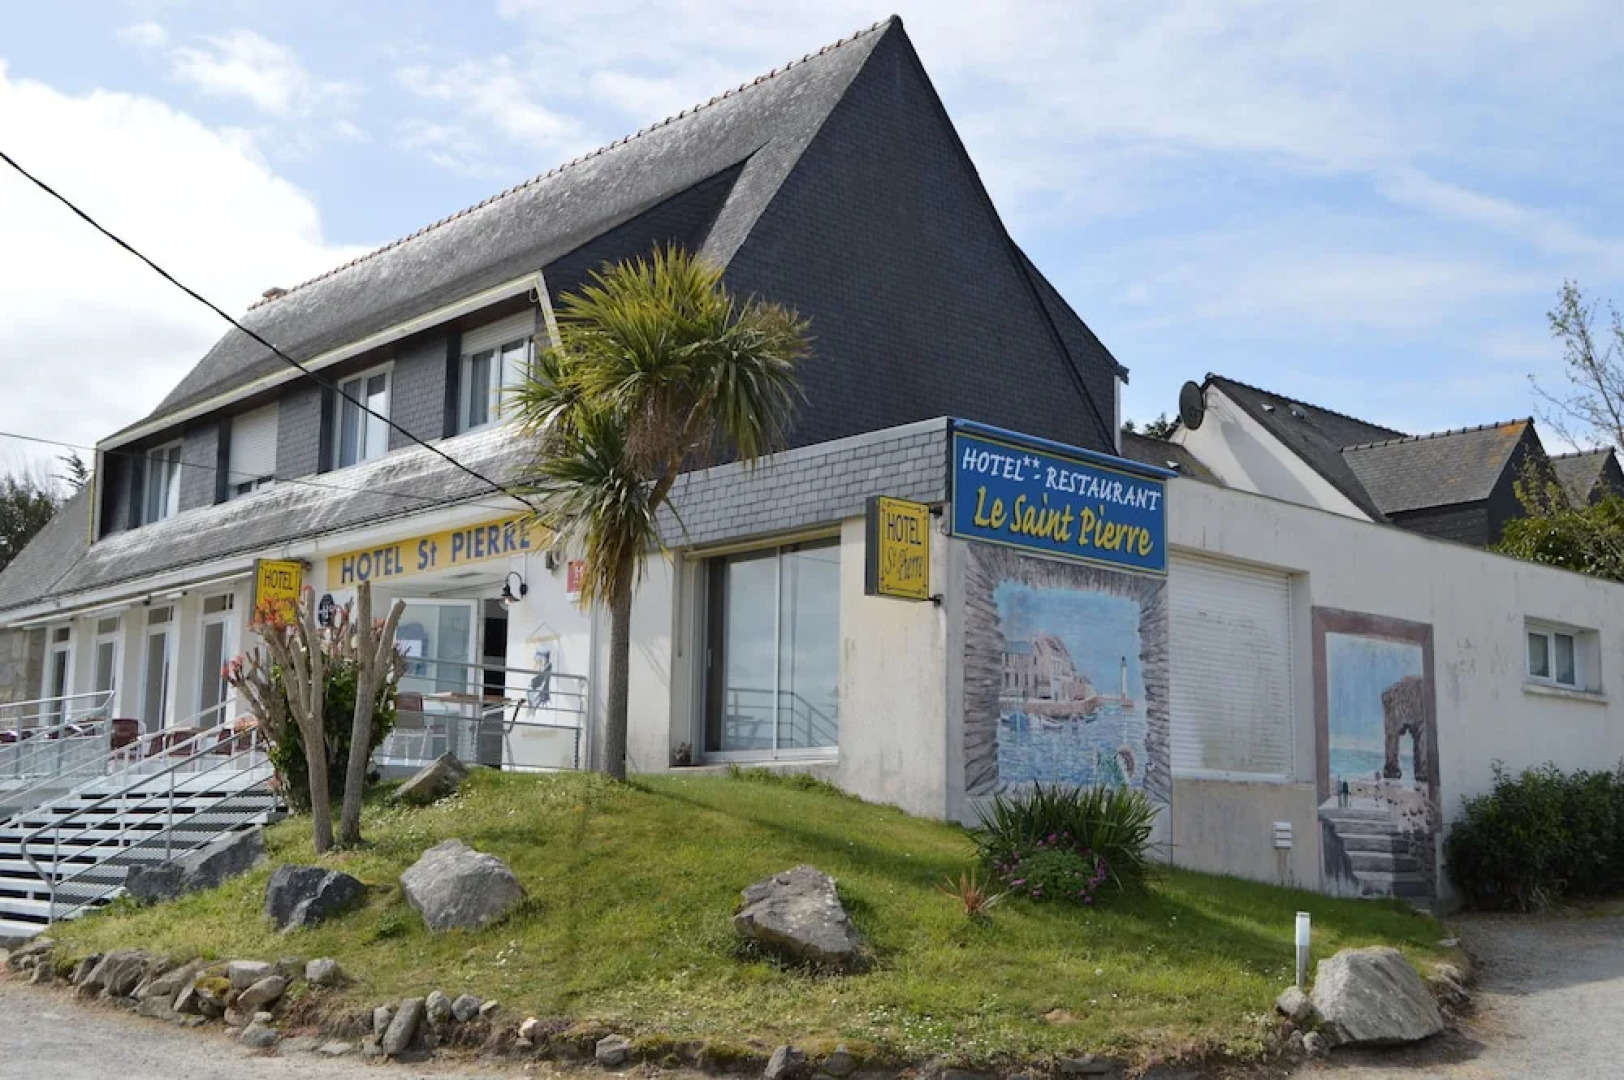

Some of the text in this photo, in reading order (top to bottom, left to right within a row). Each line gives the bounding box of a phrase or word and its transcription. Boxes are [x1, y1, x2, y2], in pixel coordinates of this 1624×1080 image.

[1046, 466, 1161, 510] RESTAURANT
[886, 512, 922, 545] HOTEL
[974, 486, 1153, 556] Le Saint Pierre
[264, 569, 293, 590] HOTEL
[341, 545, 403, 584] HOTEL
[418, 539, 437, 570] St
